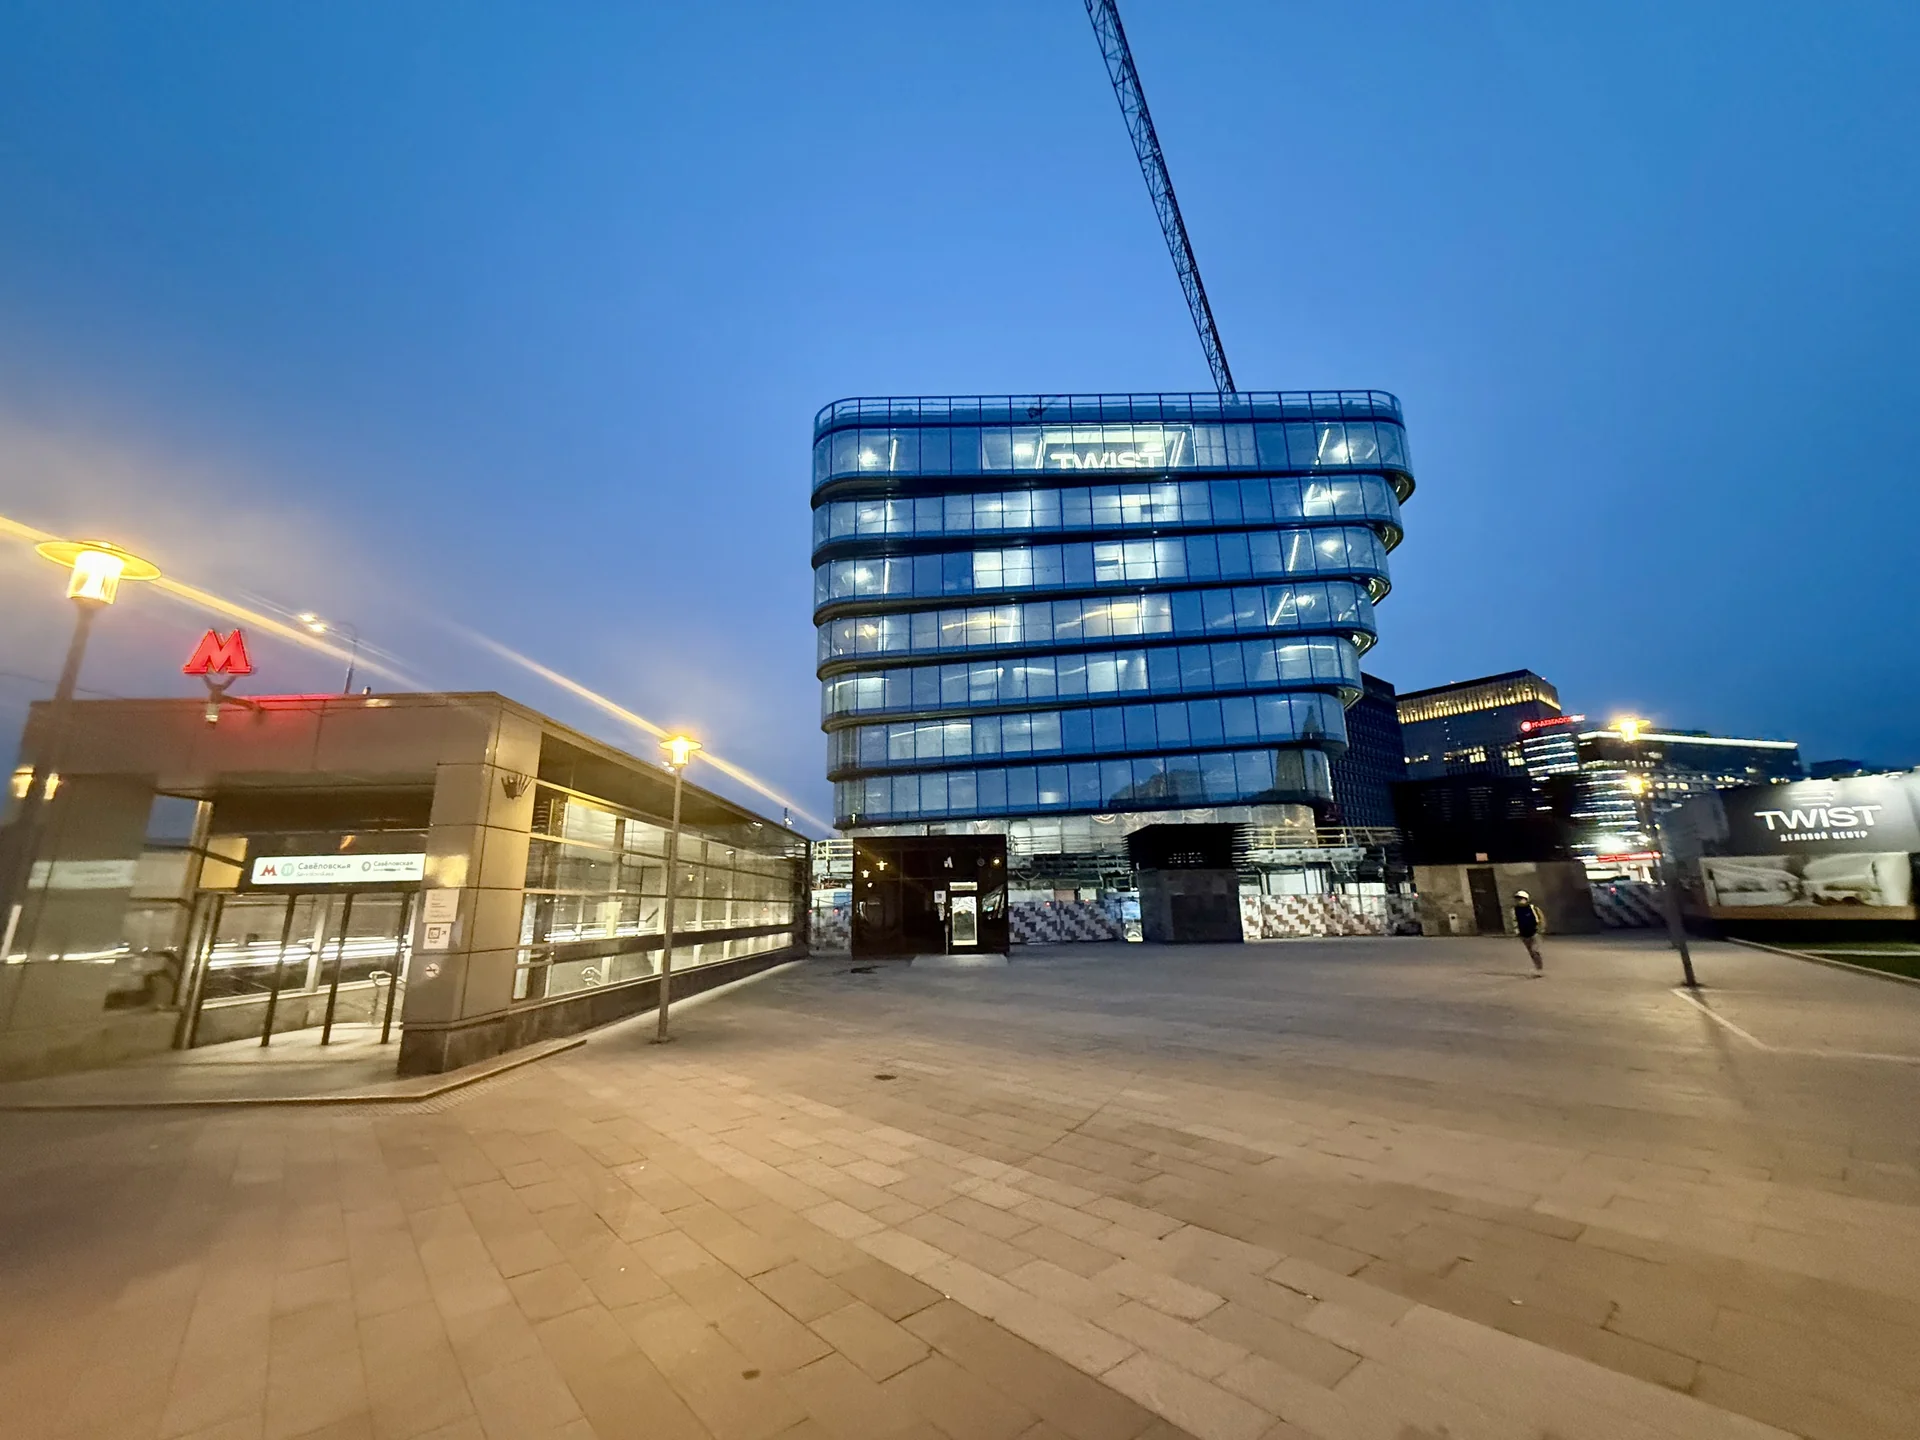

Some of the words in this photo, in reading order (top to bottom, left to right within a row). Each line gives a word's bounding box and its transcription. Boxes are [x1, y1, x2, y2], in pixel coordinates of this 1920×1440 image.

[1050, 452, 1164, 468] TWIST
[1754, 805, 1882, 831] TWIST
[1780, 831, 1828, 842] ДЕЛОВОЙ
